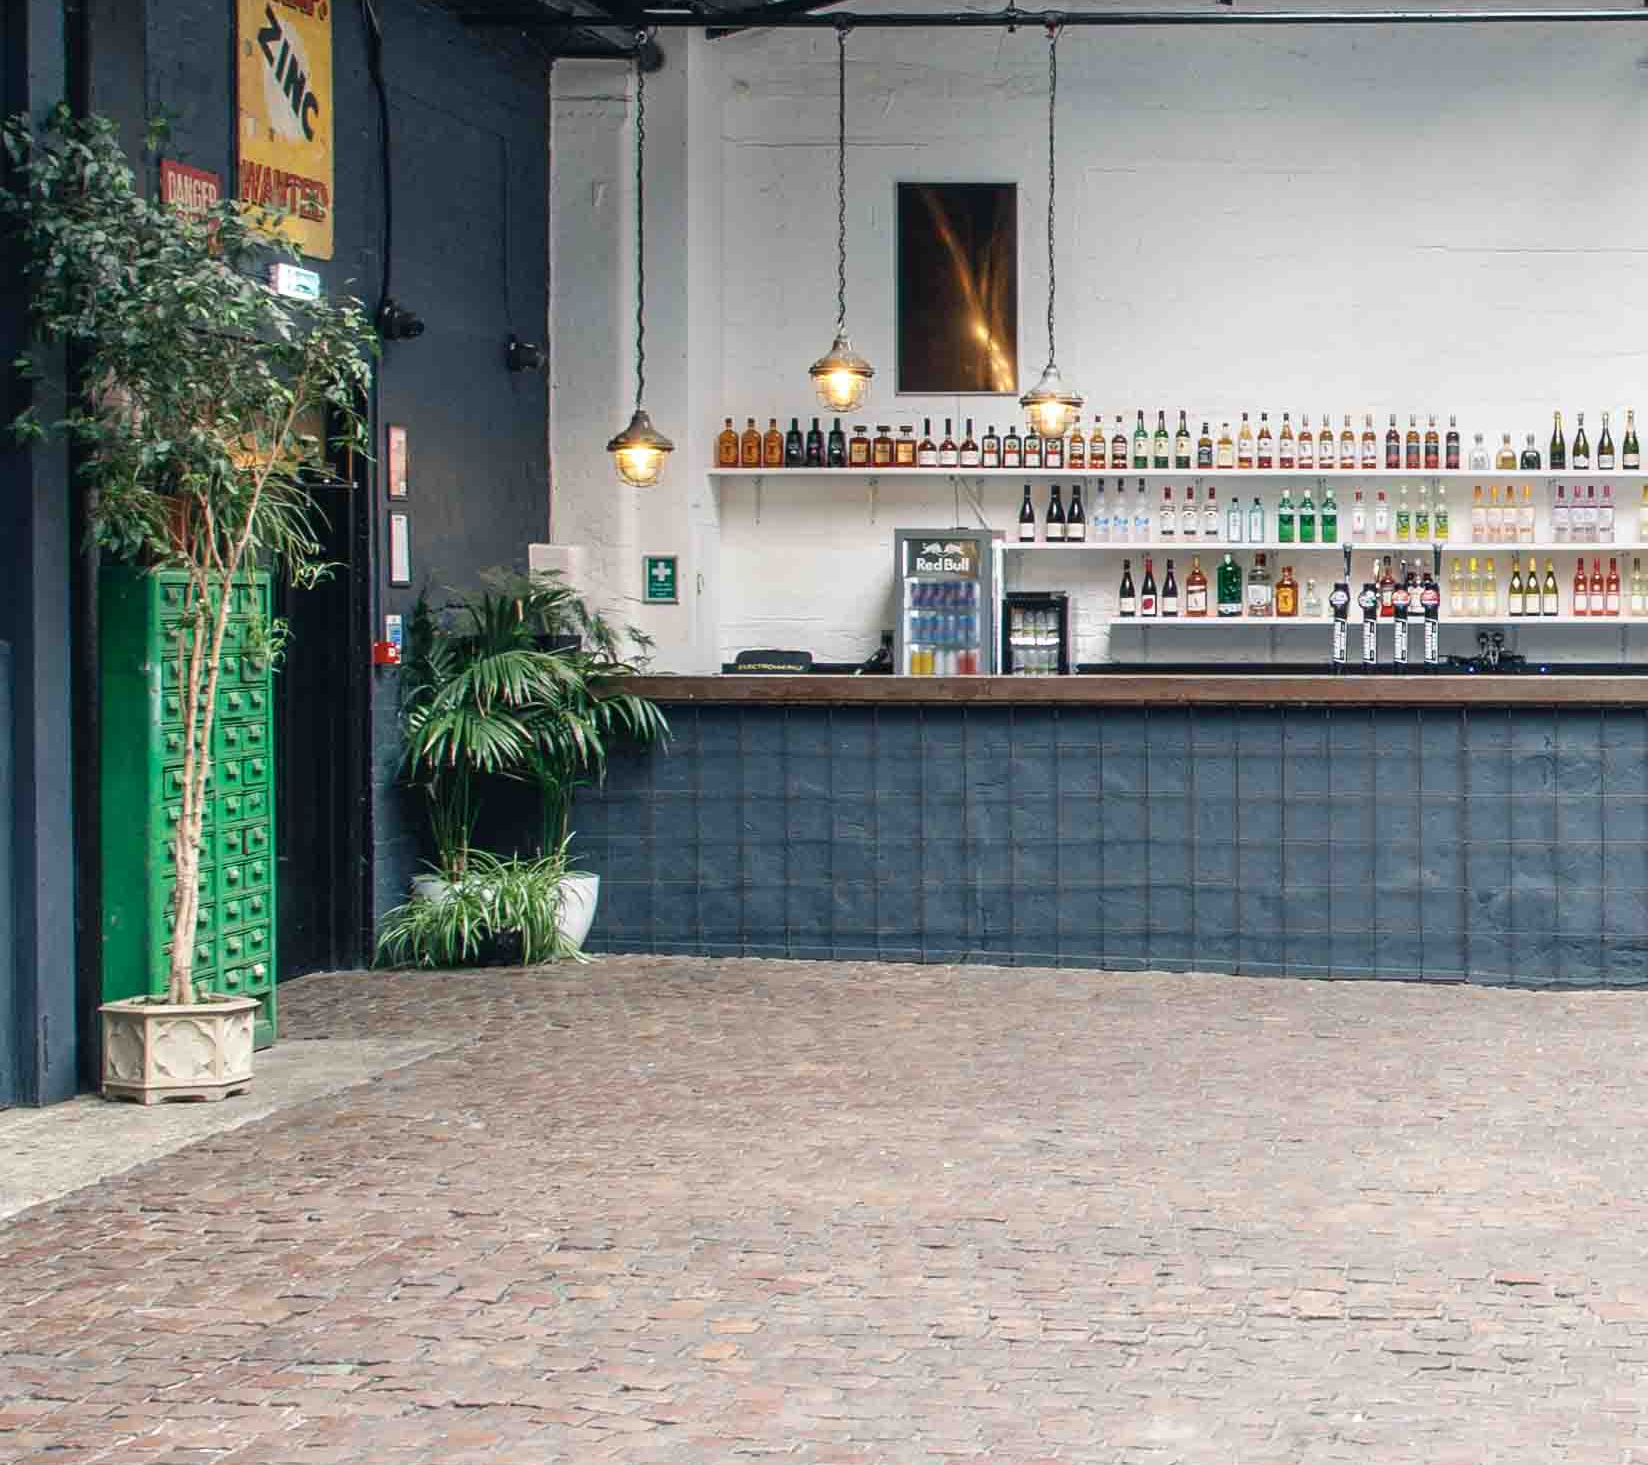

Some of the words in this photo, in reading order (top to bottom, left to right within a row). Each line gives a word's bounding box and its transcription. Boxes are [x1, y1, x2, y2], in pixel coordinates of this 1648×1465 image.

[257, 4, 319, 141] ZINC
[167, 170, 218, 215] DANGER
[240, 159, 330, 222] WANTED
[916, 557, 943, 571] Red
[944, 557, 970, 572] Bull
